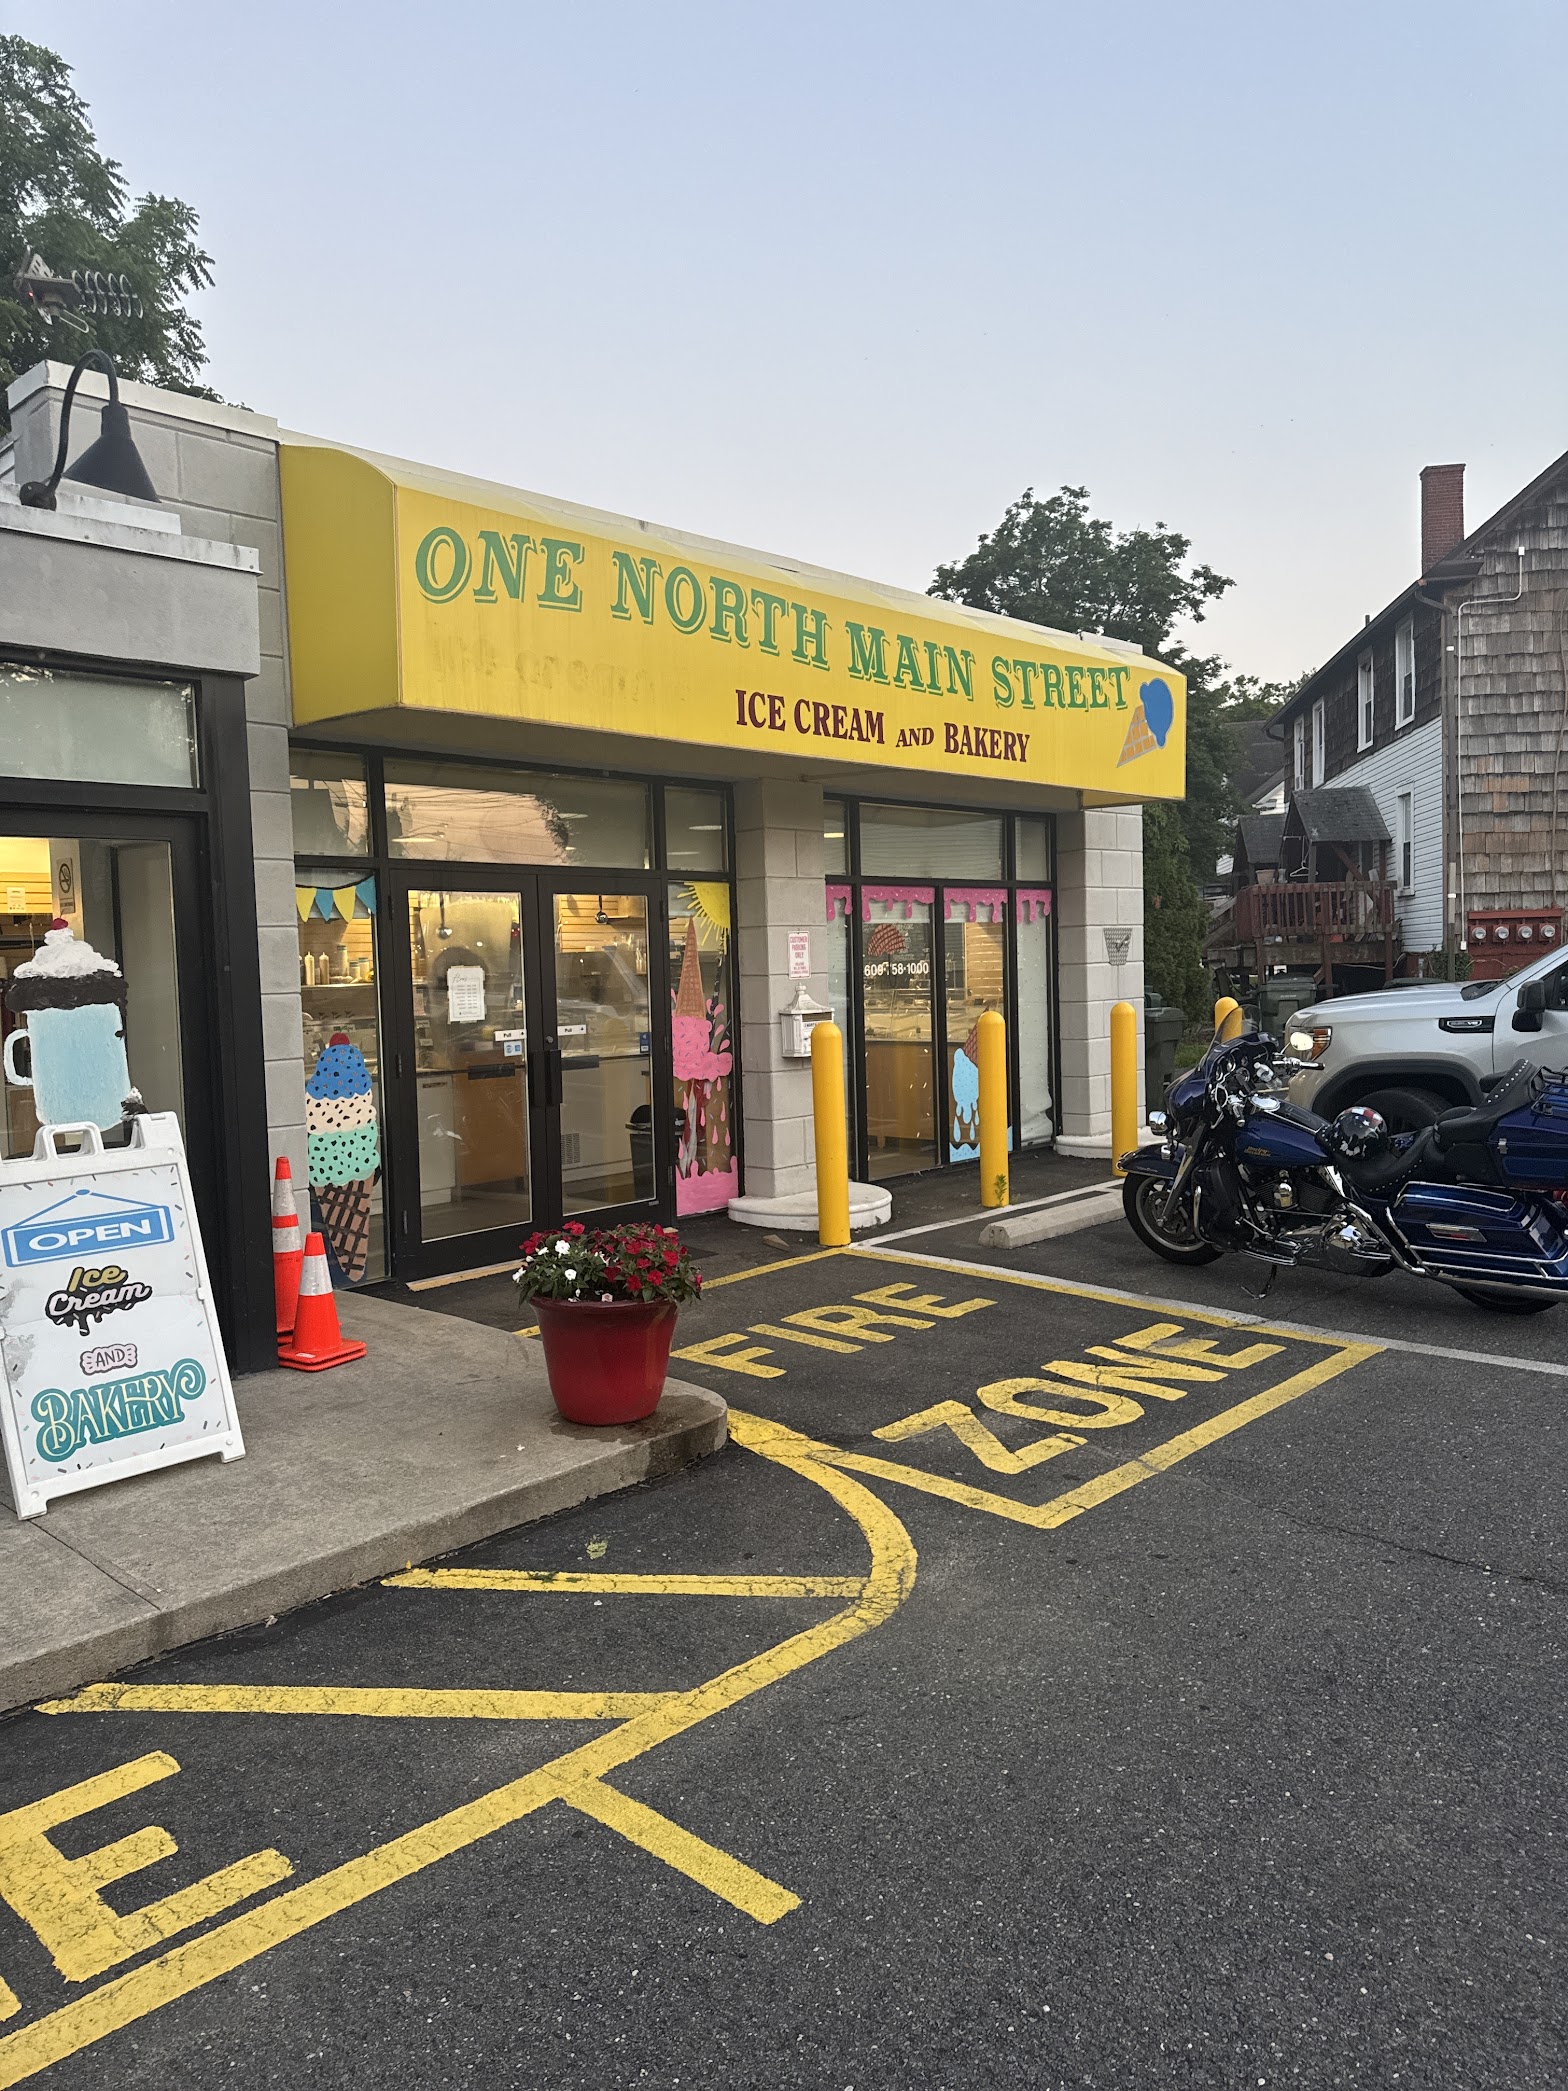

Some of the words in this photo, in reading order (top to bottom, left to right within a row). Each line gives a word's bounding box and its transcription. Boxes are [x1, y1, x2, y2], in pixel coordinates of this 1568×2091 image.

[415, 525, 586, 613] ONE
[610, 550, 832, 672] NORTH
[844, 620, 976, 702] MAIN
[991, 655, 1132, 712] STREET
[735, 689, 787, 732] ICE
[793, 698, 885, 745] CREAM
[895, 726, 935, 749] AND
[943, 722, 1031, 763] BAKERY
[28, 1218, 152, 1251] OPEN
[48, 1282, 151, 1317] Cream
[68, 1266, 127, 1293] Ice
[94, 1348, 126, 1367] AND
[670, 1282, 999, 1380] FIRE
[34, 1360, 205, 1458] BAKERY
[871, 1322, 1287, 1475] ZONE
